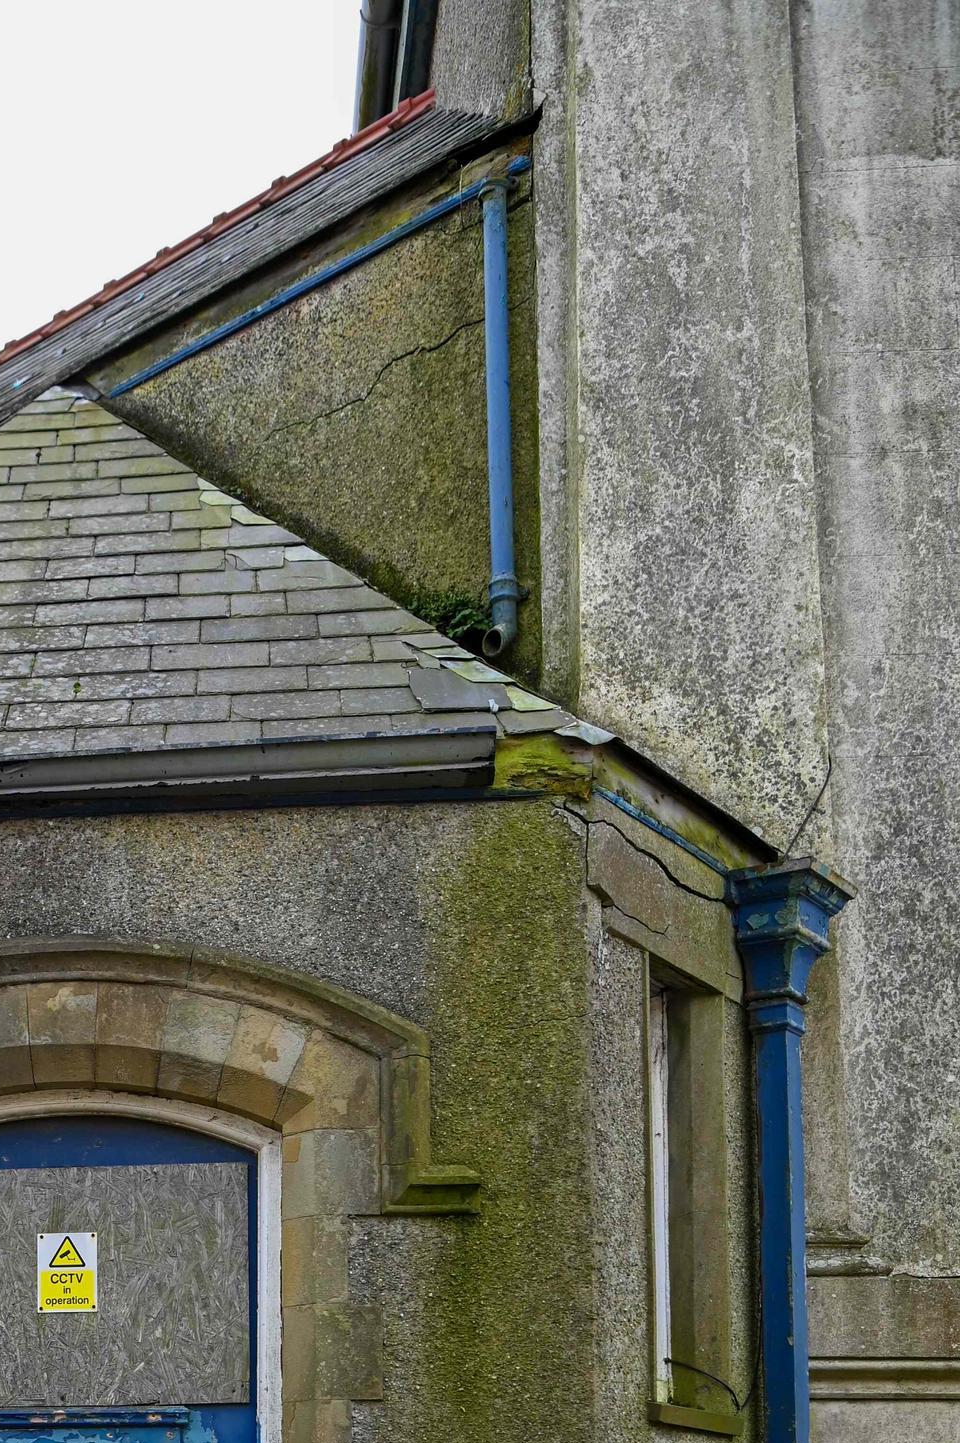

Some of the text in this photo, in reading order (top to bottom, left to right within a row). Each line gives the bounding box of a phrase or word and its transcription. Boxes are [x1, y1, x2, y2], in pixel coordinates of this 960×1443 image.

[50, 1273, 84, 1284] CCTV
[63, 1286, 71, 1294] in
[45, 1296, 89, 1307] operation
